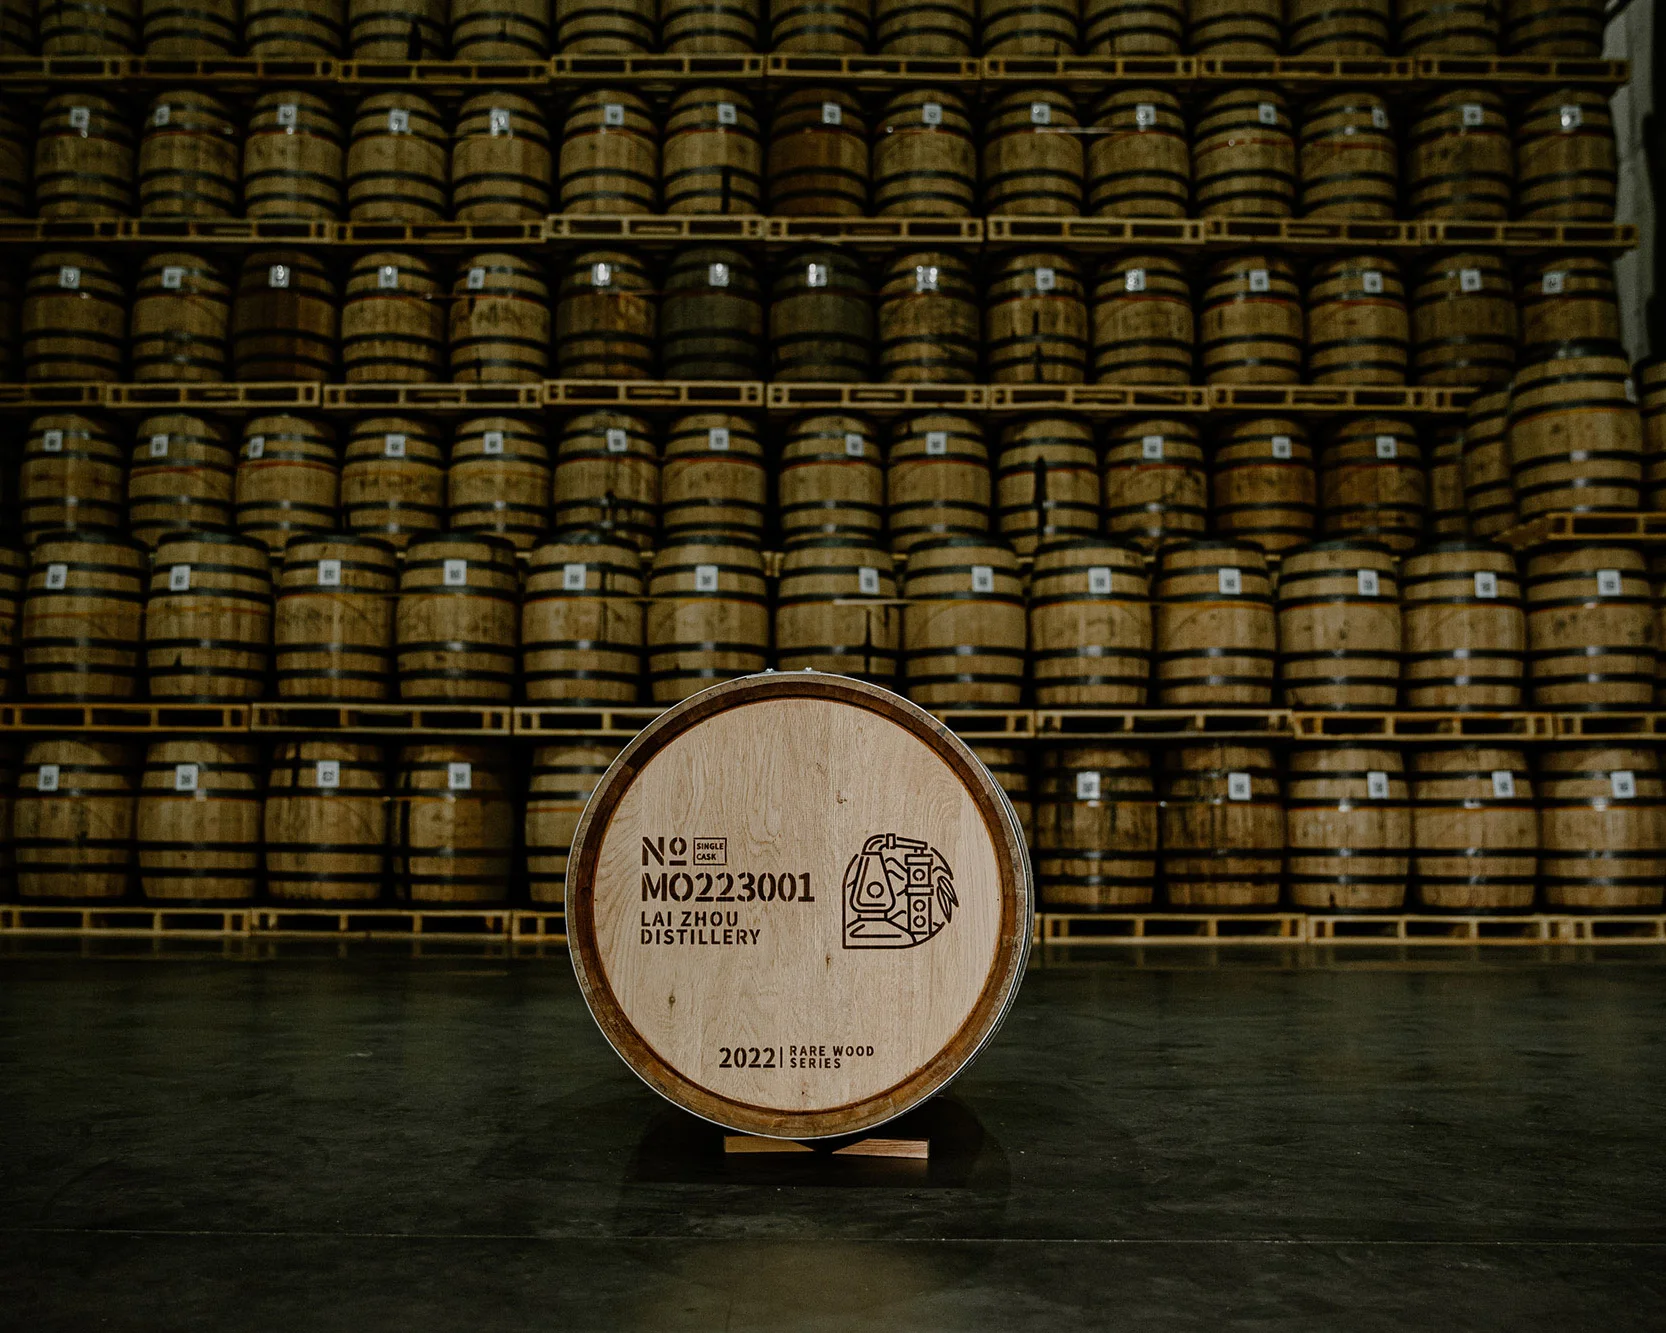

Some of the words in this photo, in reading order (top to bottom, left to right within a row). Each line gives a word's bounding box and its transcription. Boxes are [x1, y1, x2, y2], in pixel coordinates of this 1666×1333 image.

[696, 842, 725, 851] SINGLE
[696, 853, 717, 861] CASK
[640, 910, 672, 928] LAI
[680, 910, 739, 928] ZHOU
[640, 928, 761, 946] DISTILLERY
[789, 1045, 827, 1057] RARE
[832, 1045, 875, 1057] WOOD
[718, 1046, 776, 1069] 2022
[789, 1057, 842, 1069] SERIES
